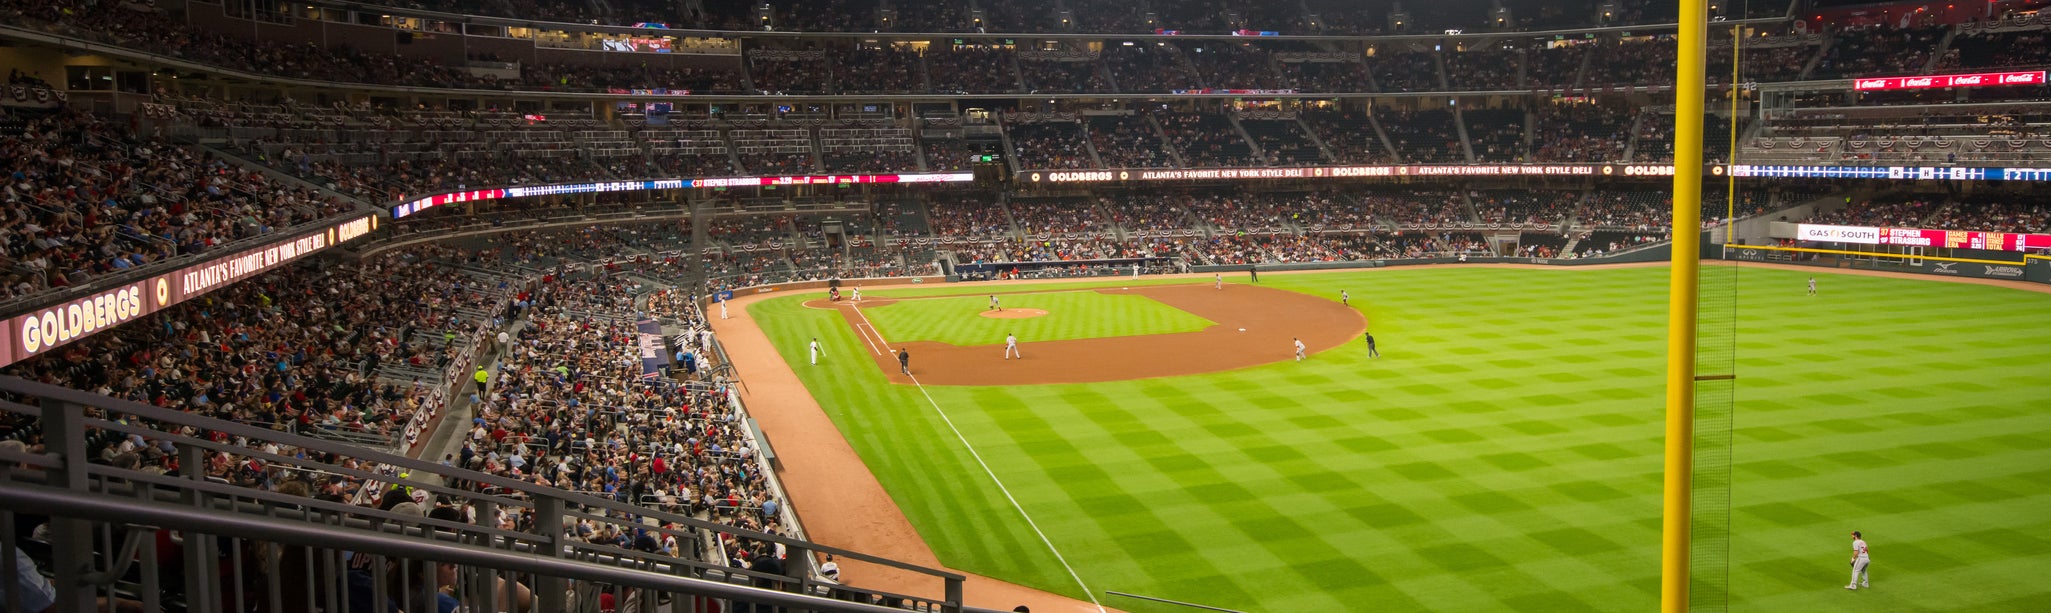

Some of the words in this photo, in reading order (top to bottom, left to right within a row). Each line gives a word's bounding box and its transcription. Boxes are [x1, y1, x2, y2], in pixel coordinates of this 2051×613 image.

[1142, 171, 1182, 180] ATLANTA'S
[1184, 170, 1220, 179] FAVORITE
[1221, 169, 1238, 178] NEW
[1239, 169, 1260, 178] YORK
[1261, 169, 1283, 178] STYLE
[1285, 168, 1302, 177] DELI
[1333, 167, 1390, 176] GOLDBERGS
[1419, 166, 1460, 175] ATLANTA'S
[1462, 166, 1500, 175] FAVORITE
[1501, 166, 1519, 175] NEW
[1521, 166, 1543, 175] YORK
[1545, 166, 1570, 175] STYLE
[1572, 166, 1592, 175] DELI
[1049, 171, 1112, 182] GOLDBERGS
[339, 217, 369, 242] GOLDBERGS
[1809, 229, 1829, 237] GAS
[1841, 230, 1875, 240] SOUTH
[1880, 228, 1888, 236] 37
[1890, 228, 1921, 238] STEPHEN
[1889, 236, 1931, 246] STRASBURG
[184, 263, 228, 295] ATLANTA'S
[230, 252, 264, 279] FAVORITE
[265, 249, 279, 267] NEW
[278, 244, 296, 262] YORK
[296, 238, 313, 256] STYLE
[313, 234, 325, 250] DELI
[23, 285, 141, 353] GOLDBERGS
